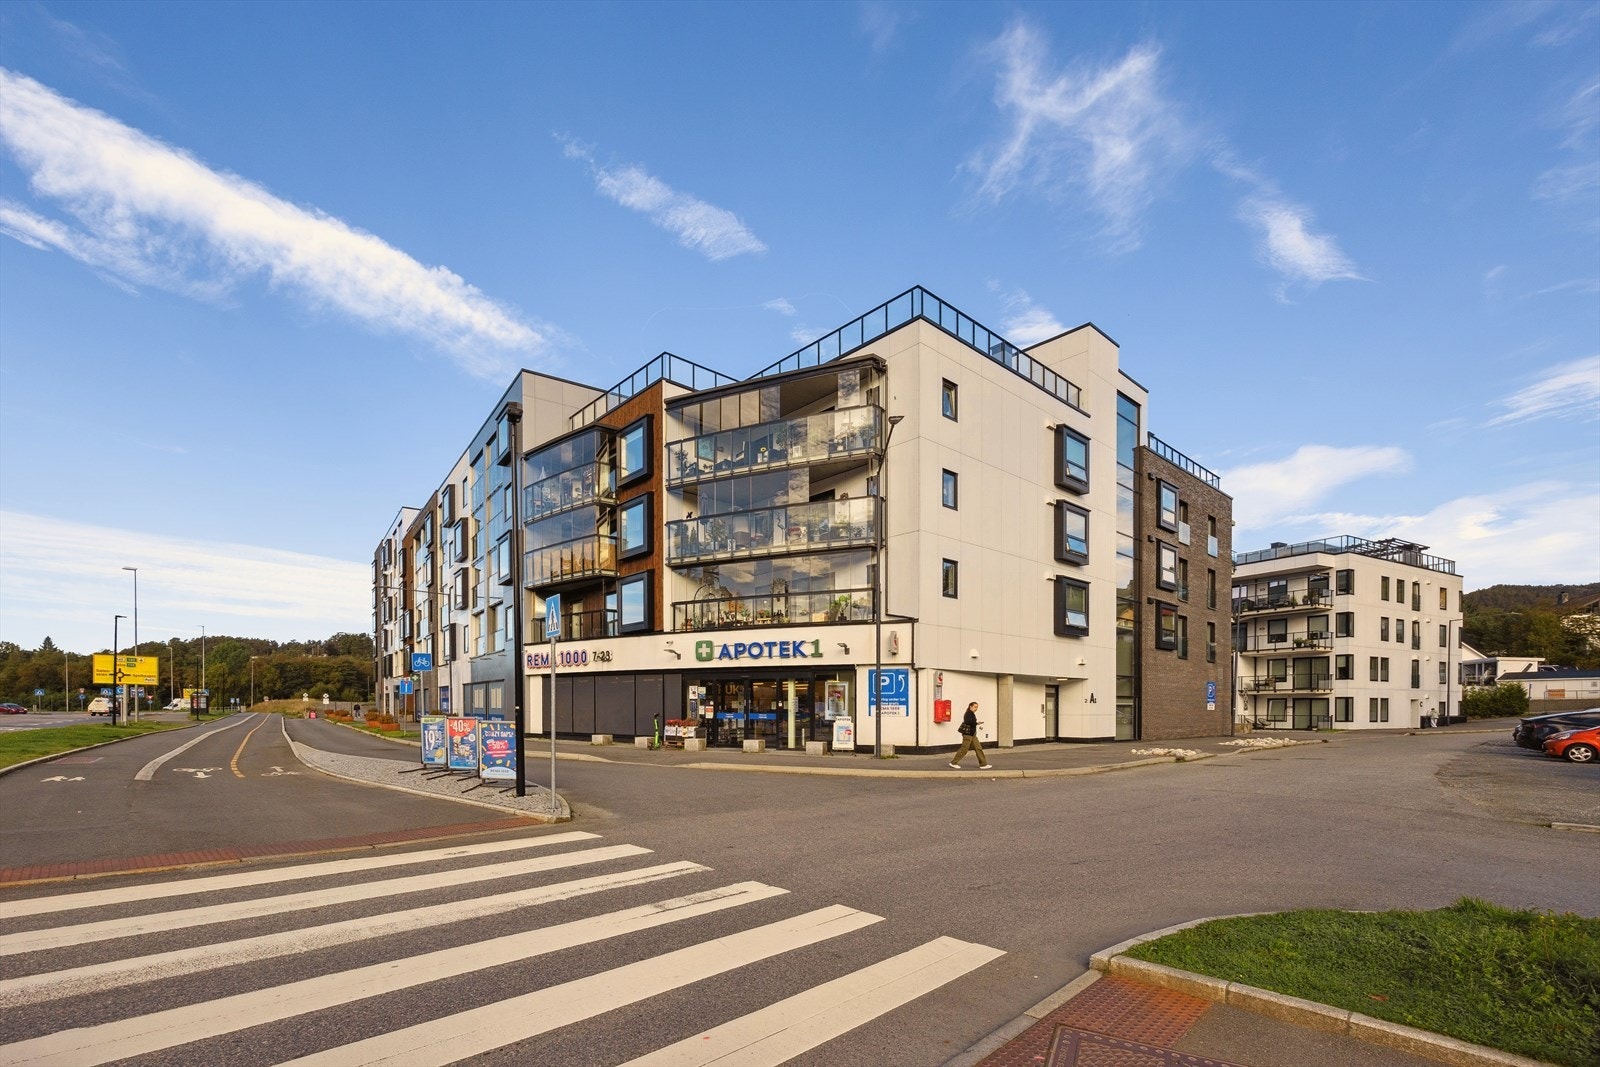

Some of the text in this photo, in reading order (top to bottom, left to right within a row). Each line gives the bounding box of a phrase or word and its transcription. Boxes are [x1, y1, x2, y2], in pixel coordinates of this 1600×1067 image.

[527, 653, 557, 666] REM
[560, 650, 587, 664] 1000
[719, 639, 823, 660] APOTEK 1
